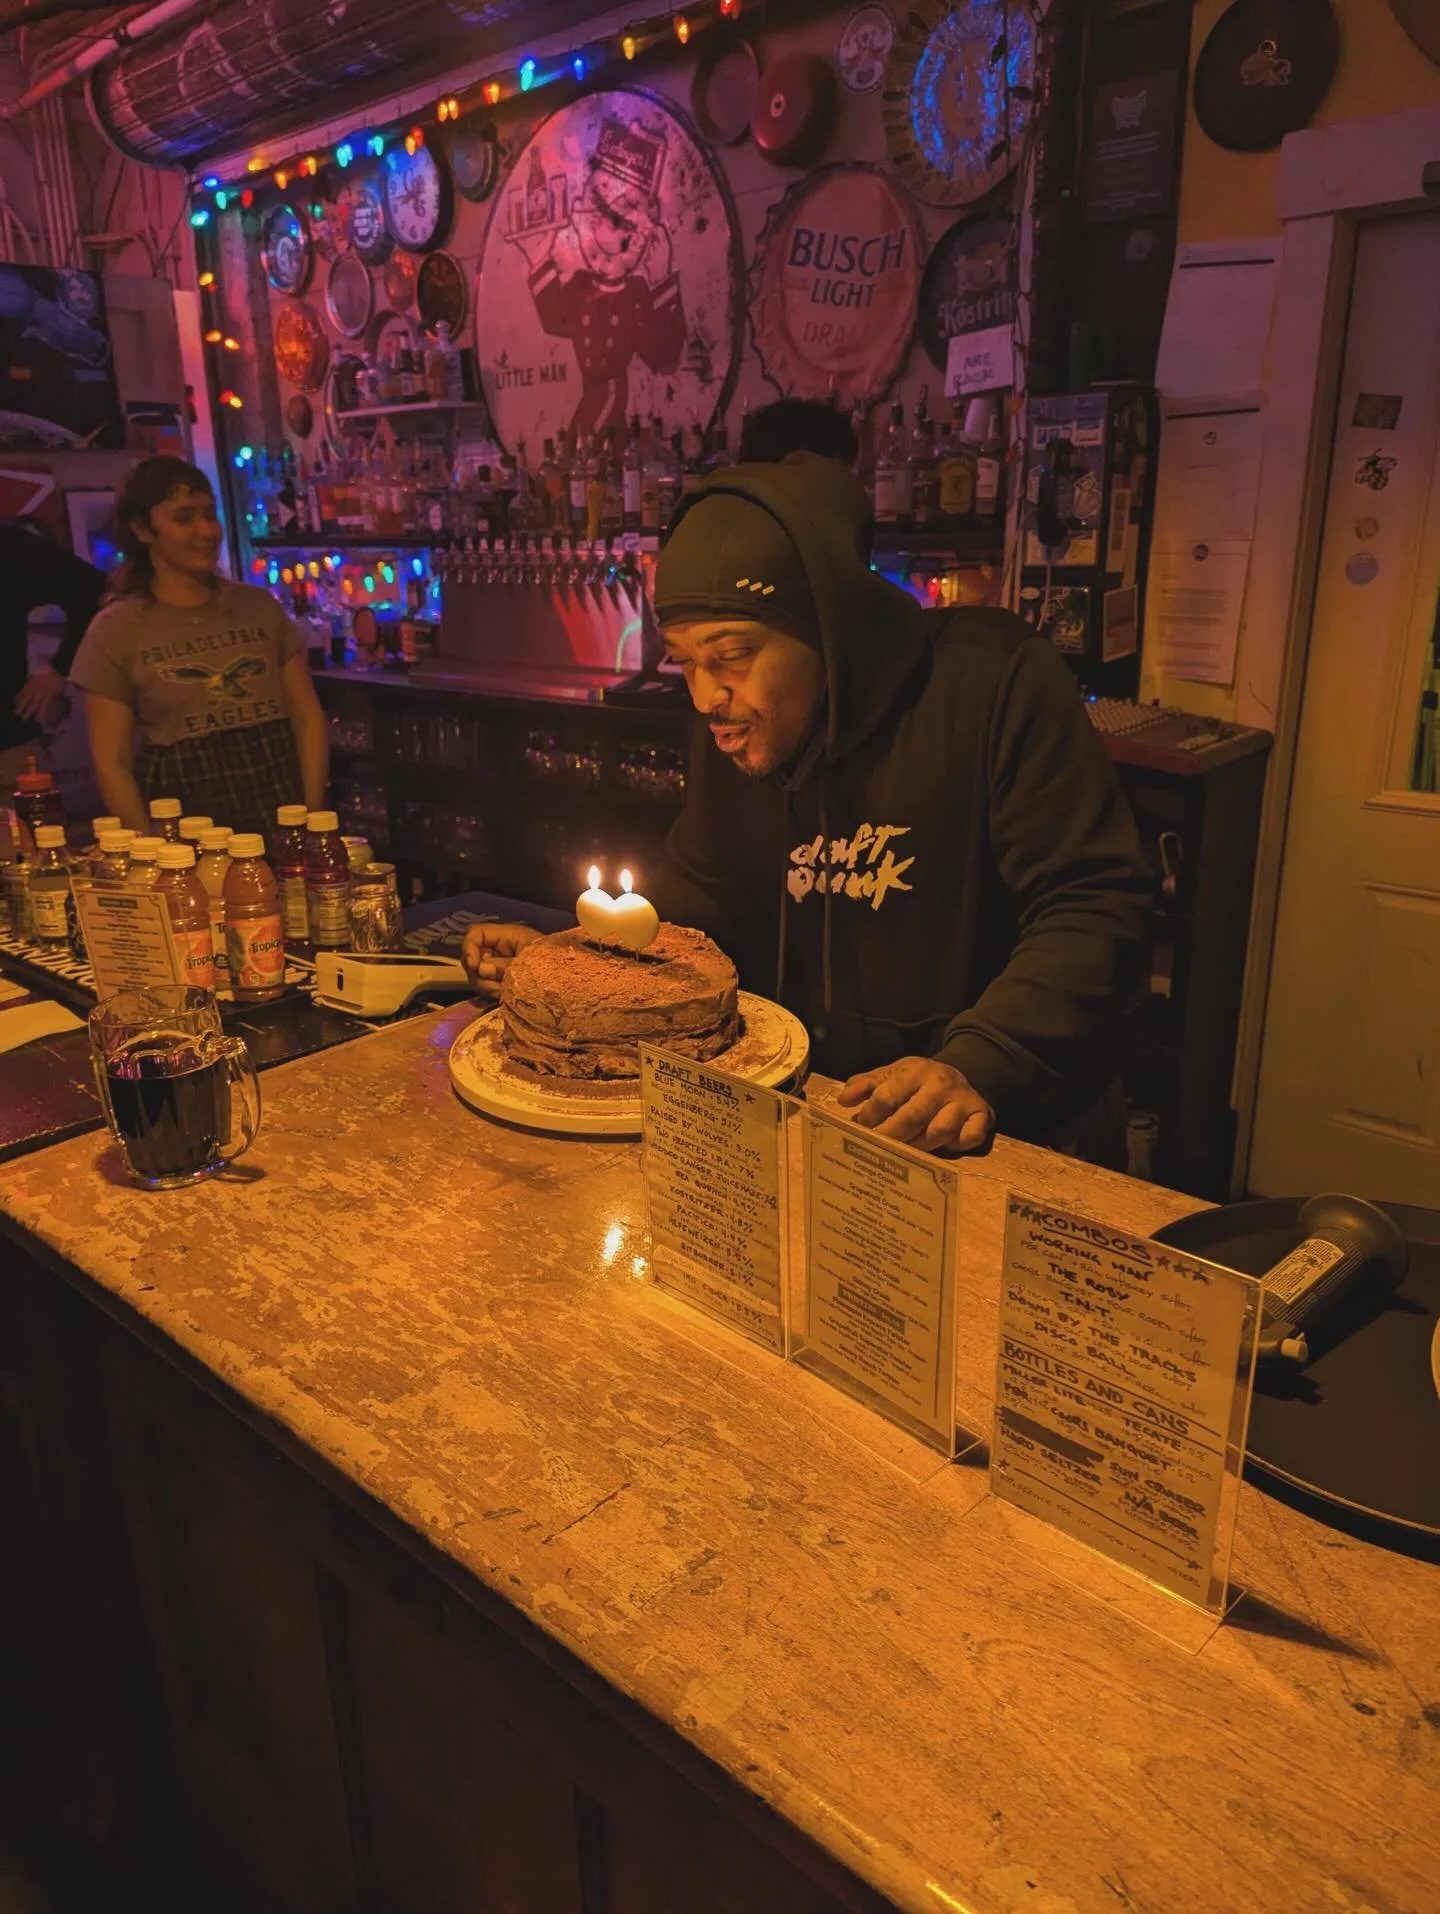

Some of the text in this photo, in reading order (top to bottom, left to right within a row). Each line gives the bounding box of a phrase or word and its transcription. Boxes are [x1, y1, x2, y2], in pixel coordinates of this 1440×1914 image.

[788, 227, 907, 277] BUSCH
[810, 278, 877, 309] LIGHT
[495, 362, 567, 390] LITTLE MAN
[963, 353, 994, 371] ARE
[140, 627, 269, 667] PHILADELPHIA
[185, 698, 281, 733] EAGLES
[654, 1071, 675, 1088] BLUE
[680, 1081, 705, 1099] MOON
[658, 1058, 732, 1097] DRAFT BEERS
[650, 1104, 677, 1125] RAISED
[681, 1119, 692, 1130] BY
[695, 1125, 729, 1147] WOLVES
[662, 1092, 715, 1121] EGGENBERG
[653, 1124, 669, 1140] TWO
[672, 1134, 707, 1157] HEARTED
[679, 1154, 712, 1177] RANGER
[1041, 1211, 1152, 1262] COMBOS
[1027, 1228, 1156, 1286] WORKING MAN
[1046, 1259, 1080, 1284] THE
[1057, 1287, 1115, 1323] T.N.T.
[1033, 1319, 1137, 1379] DISCO BALL
[1055, 1308, 1081, 1330] BY
[1086, 1323, 1121, 1348] THE
[1127, 1341, 1198, 1384] TRACKS
[1002, 1361, 1049, 1390] MILLER
[1052, 1384, 1088, 1408] LITE
[1002, 1338, 1080, 1386] BOTTLES
[1084, 1376, 1124, 1407] AND
[1130, 1397, 1190, 1437] CANS
[1049, 1403, 1090, 1434] COORS
[1093, 1425, 1172, 1473] BANQUET
[1120, 1415, 1182, 1453] TECATE
[1038, 1446, 1105, 1488] SELTZER
[1123, 1489, 1155, 1516] N/A
